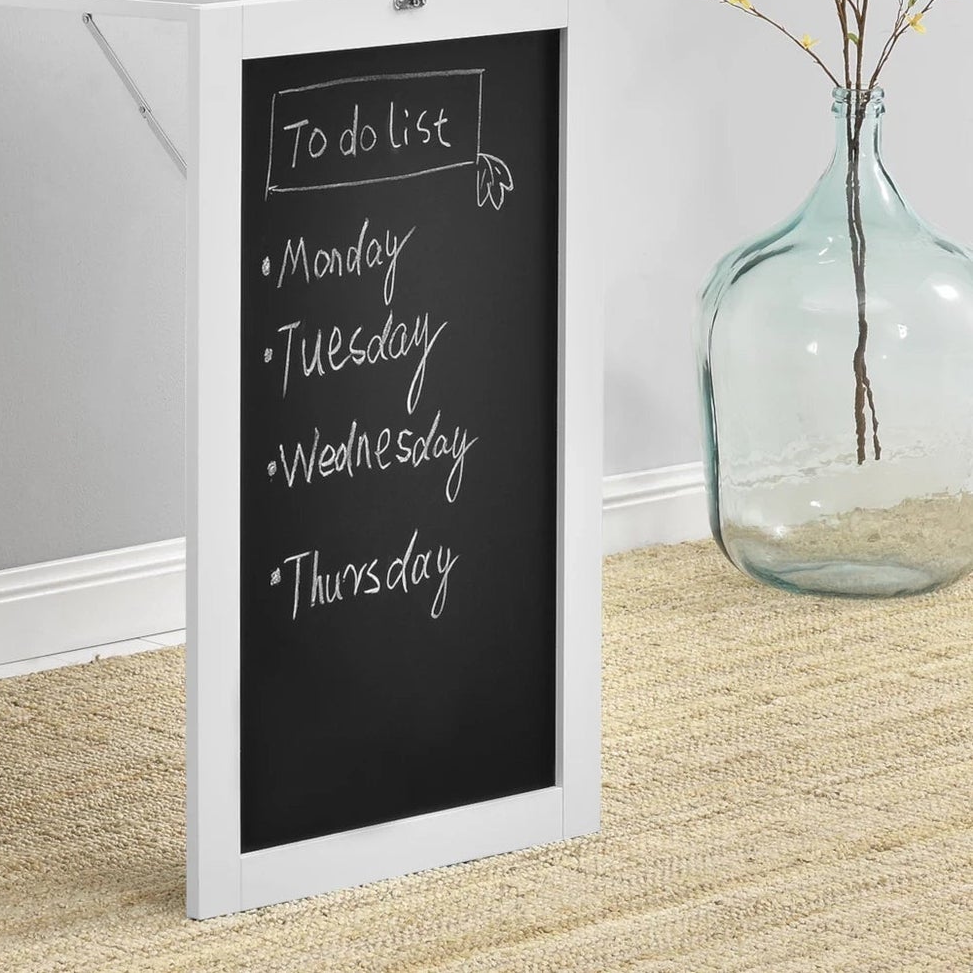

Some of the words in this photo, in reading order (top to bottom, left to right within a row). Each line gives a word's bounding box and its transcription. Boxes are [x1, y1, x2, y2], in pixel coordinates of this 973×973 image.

[283, 118, 327, 168] To
[340, 104, 377, 158] do
[389, 101, 452, 148] list
[277, 217, 416, 306] Monday
[278, 309, 448, 415] Tuesday
[279, 409, 479, 503] Wednesday
[283, 528, 459, 619] Thursday
